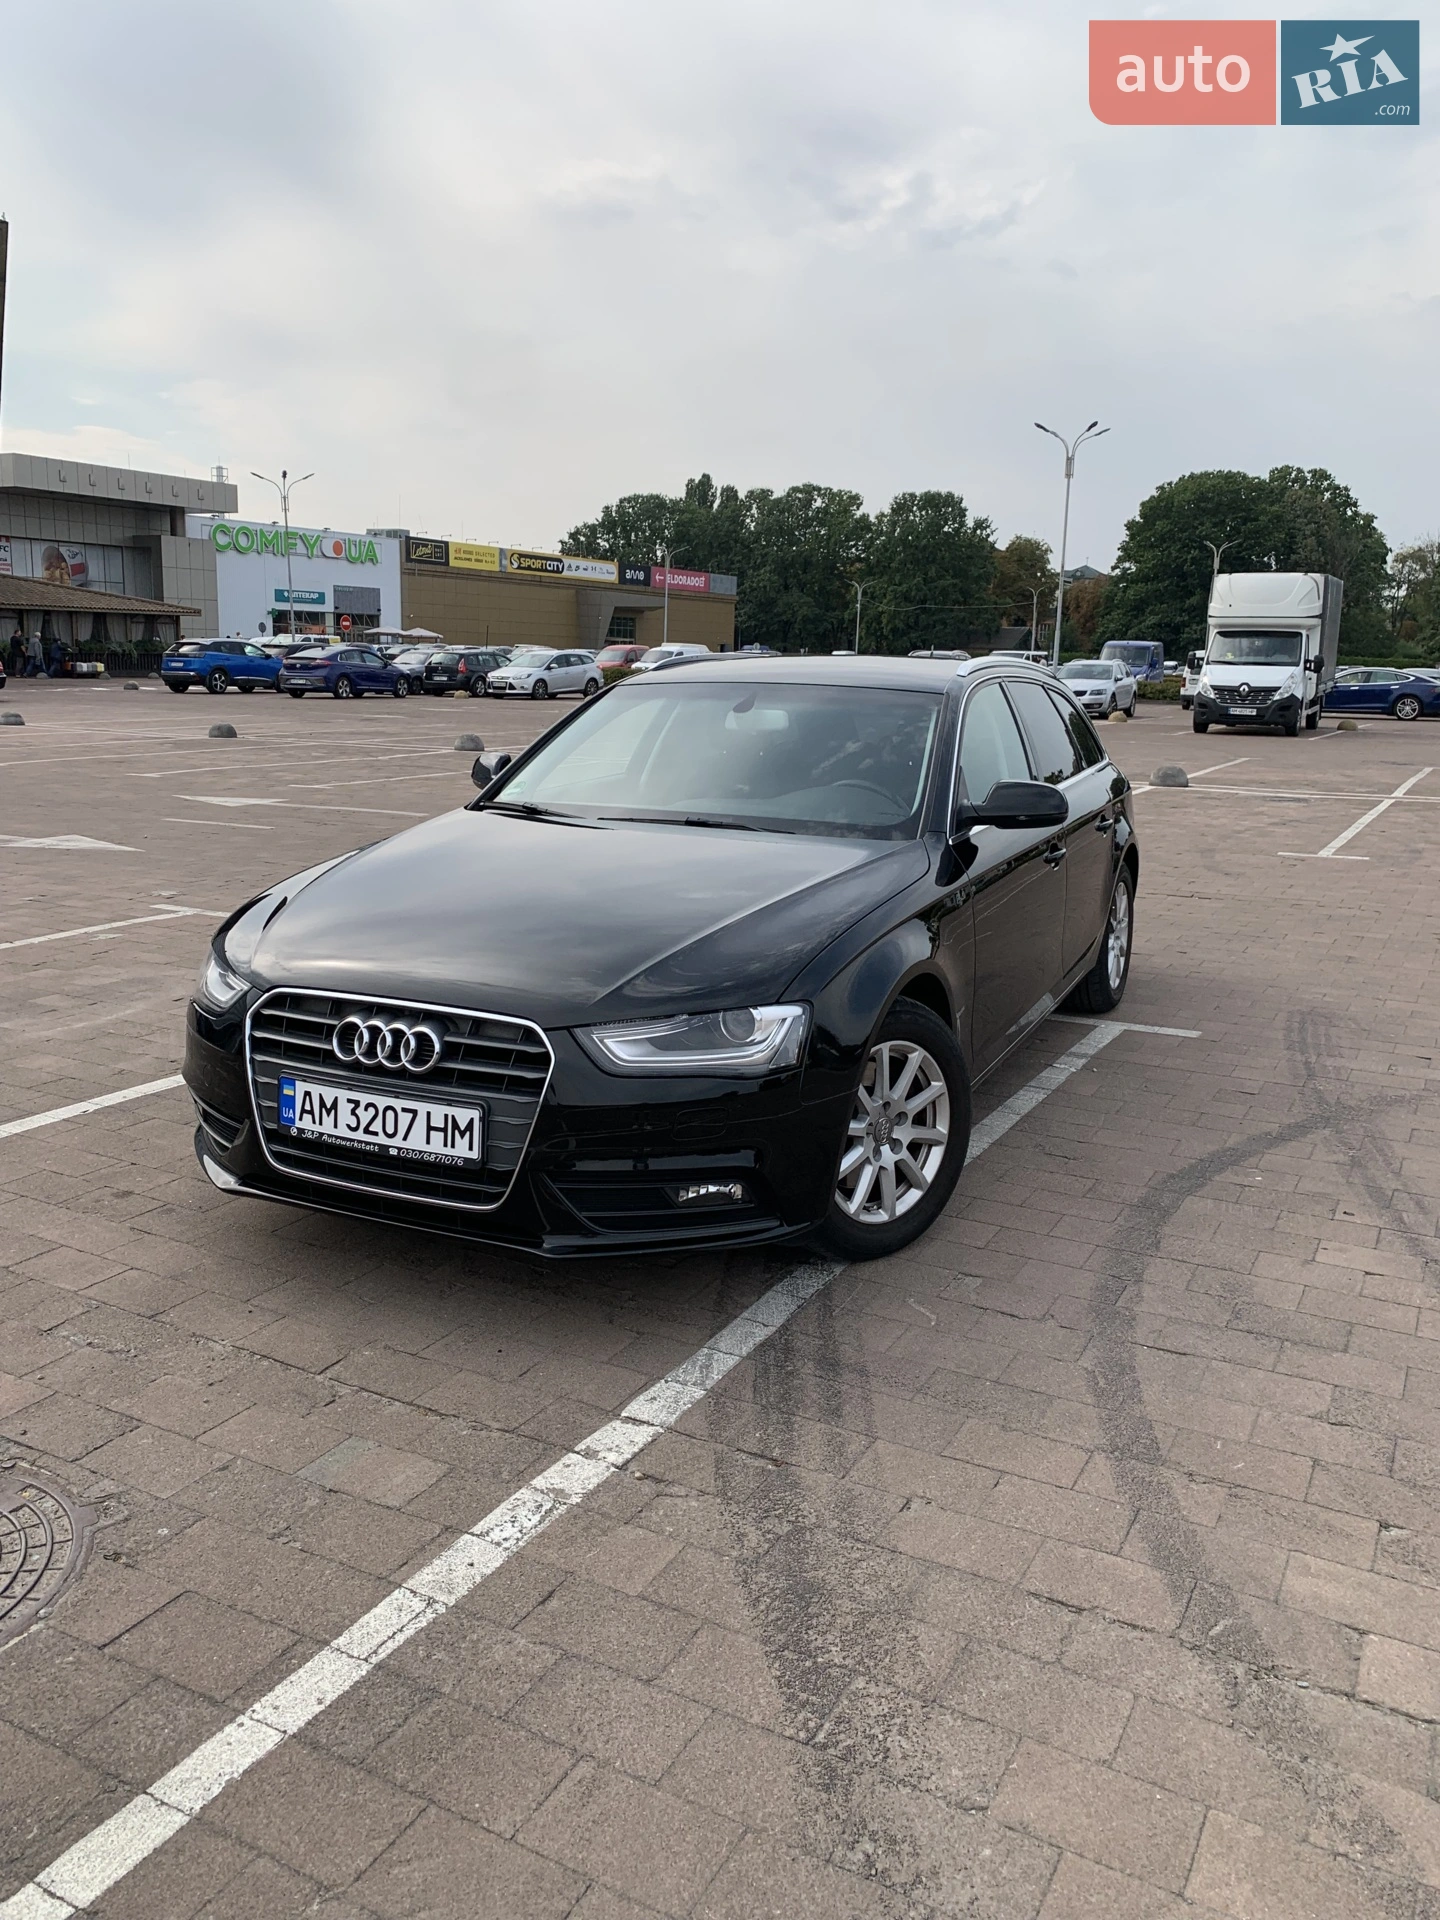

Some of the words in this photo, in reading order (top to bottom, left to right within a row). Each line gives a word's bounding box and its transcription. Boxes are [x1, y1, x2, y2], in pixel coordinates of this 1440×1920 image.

[211, 523, 321, 559] COMFY
[345, 537, 379, 565] UA
[282, 1106, 295, 1119] UA
[298, 1090, 339, 1129] AM
[345, 1098, 418, 1142] 3207
[425, 1110, 475, 1152] HM
[301, 1130, 319, 1139] J&P
[321, 1135, 379, 1152] Autowerkstatt
[400, 1149, 464, 1166] 030/6871076
